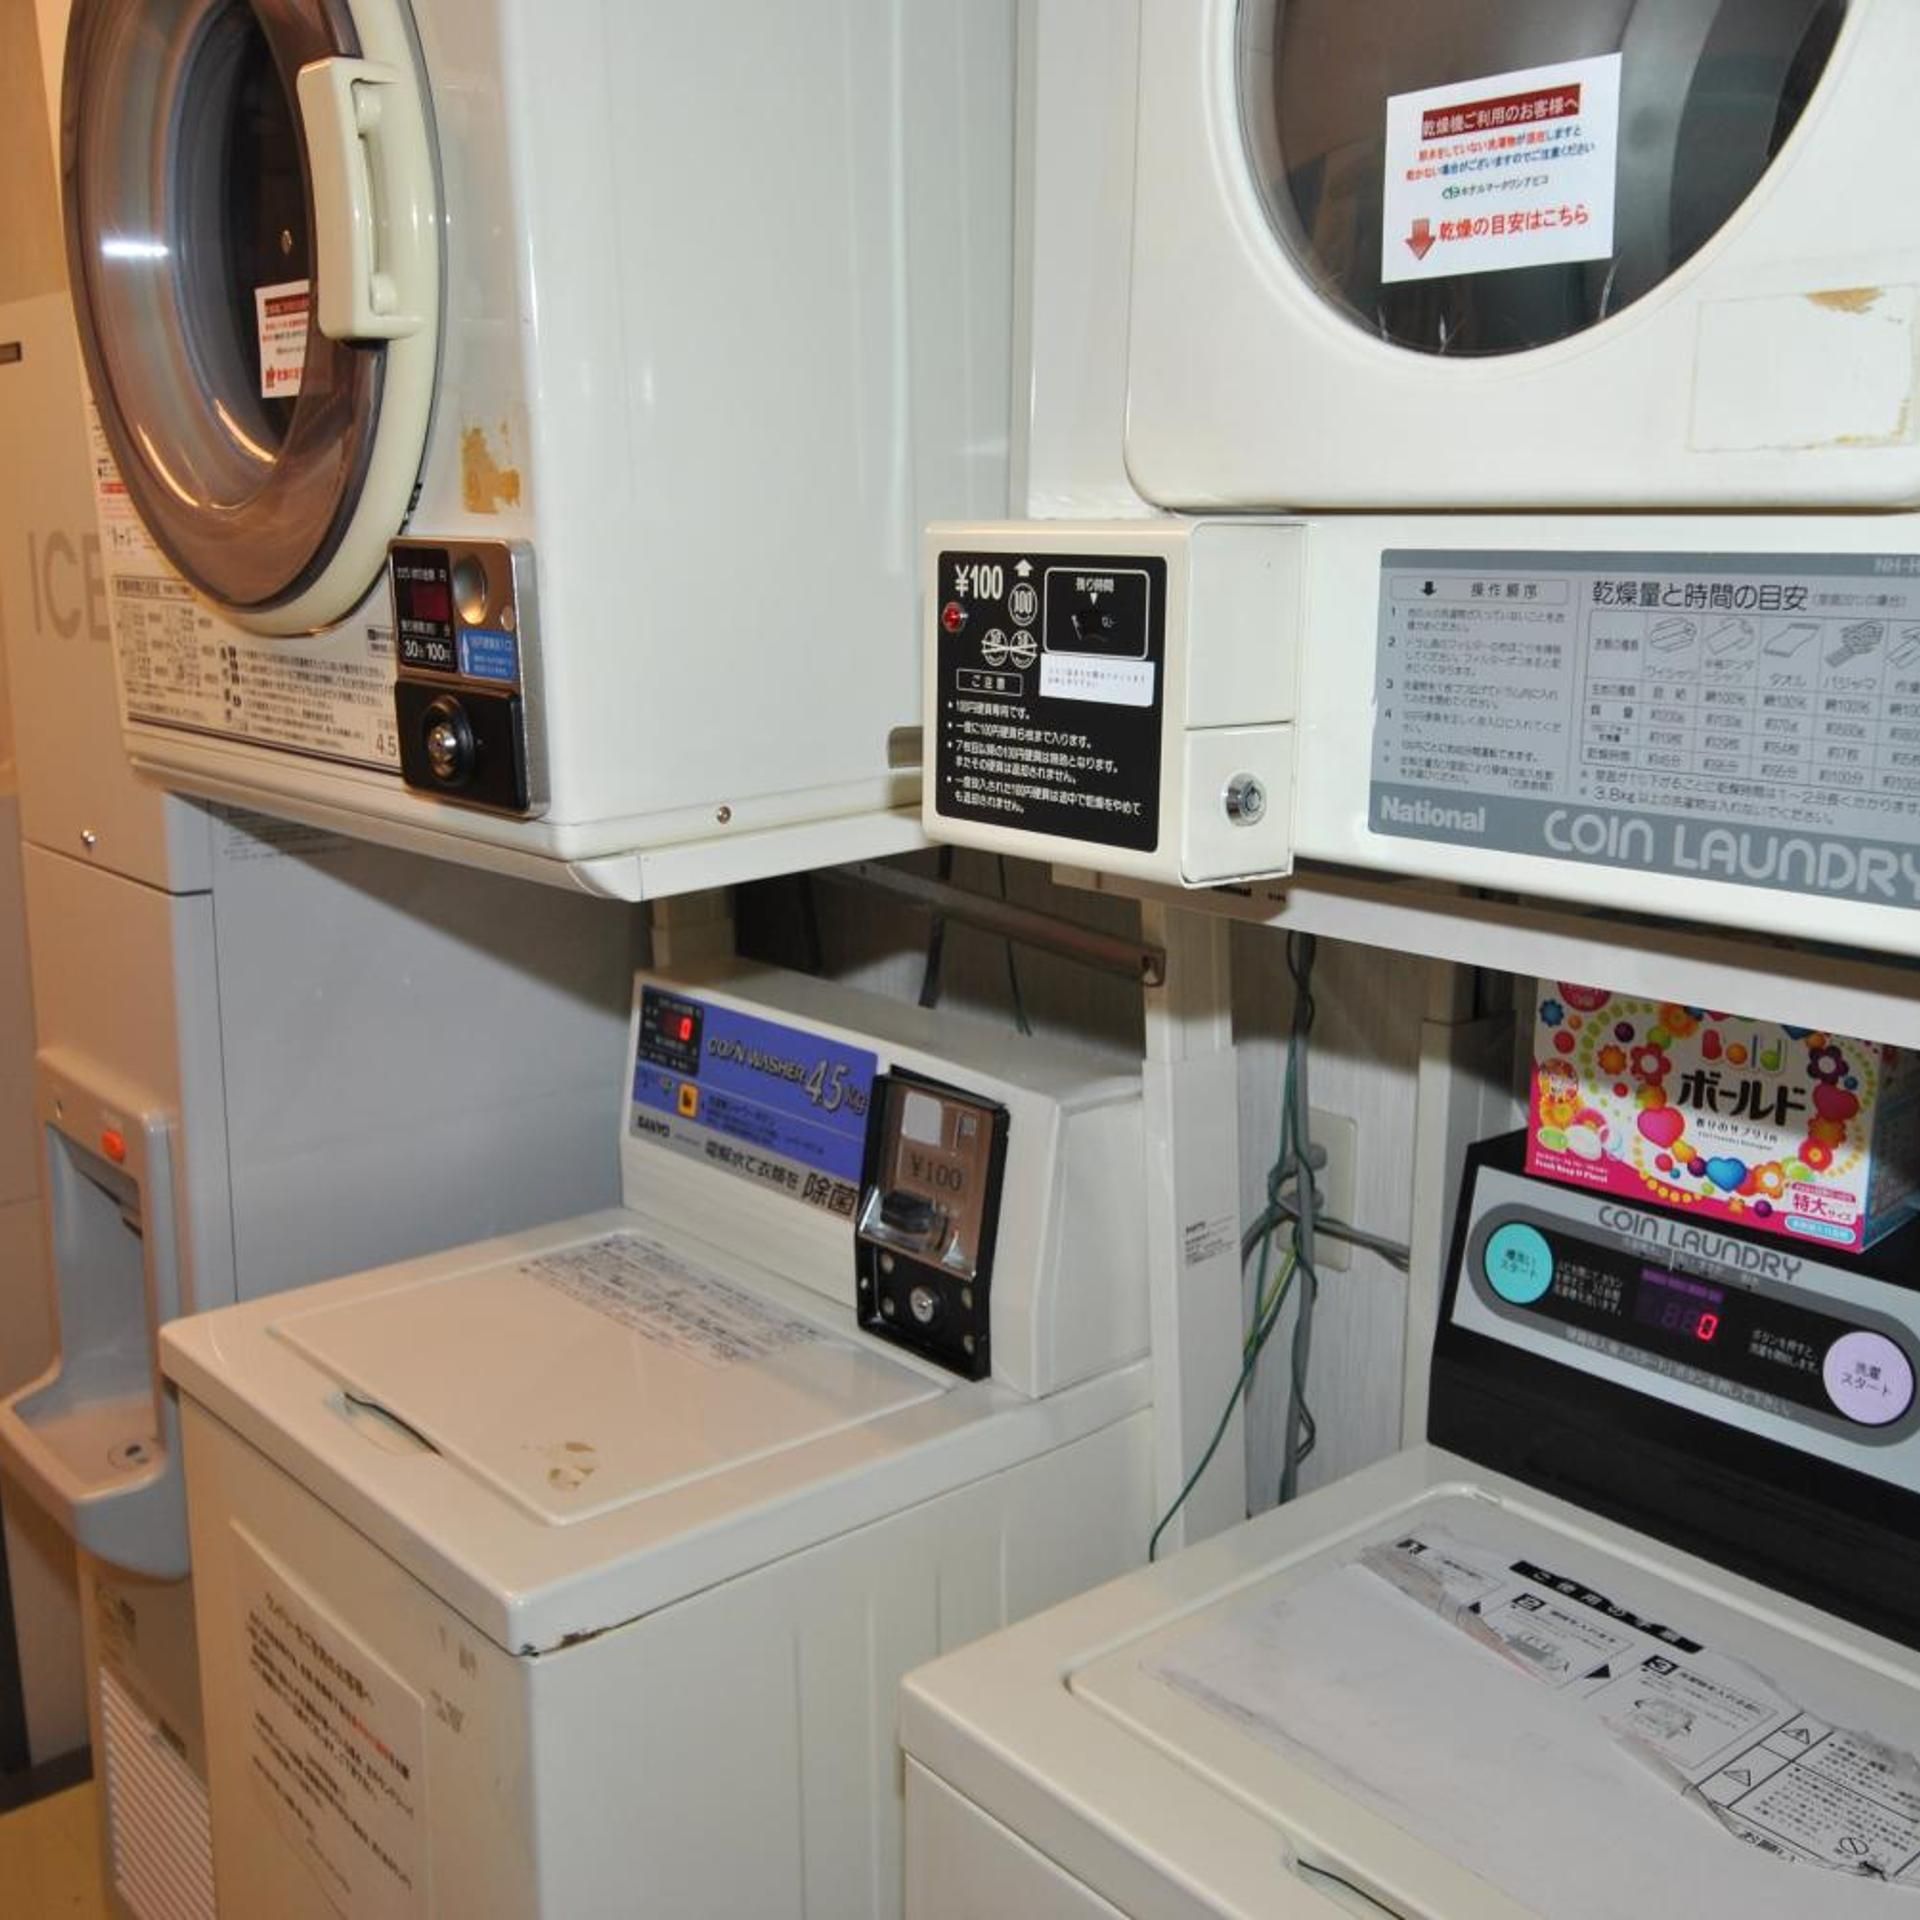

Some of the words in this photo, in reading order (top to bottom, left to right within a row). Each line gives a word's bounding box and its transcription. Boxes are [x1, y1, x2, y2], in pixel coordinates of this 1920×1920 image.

[1439, 203, 1590, 242] 乾燥の目安はこちら
[954, 564, 1004, 600] ¥100
[1592, 580, 1808, 611] 乾燥量と時間の目安
[1380, 794, 1486, 833] National
[1543, 809, 1654, 864] COIN
[1676, 1069, 1806, 1127] ボールド
[637, 1115, 671, 1138] SANYO
[909, 1150, 963, 1192] ¥100
[802, 1171, 861, 1217] 除菌
[1598, 1205, 1660, 1241] COIN
[1667, 1223, 1804, 1282] LAUNDRY
[1696, 1313, 1720, 1342] 0
